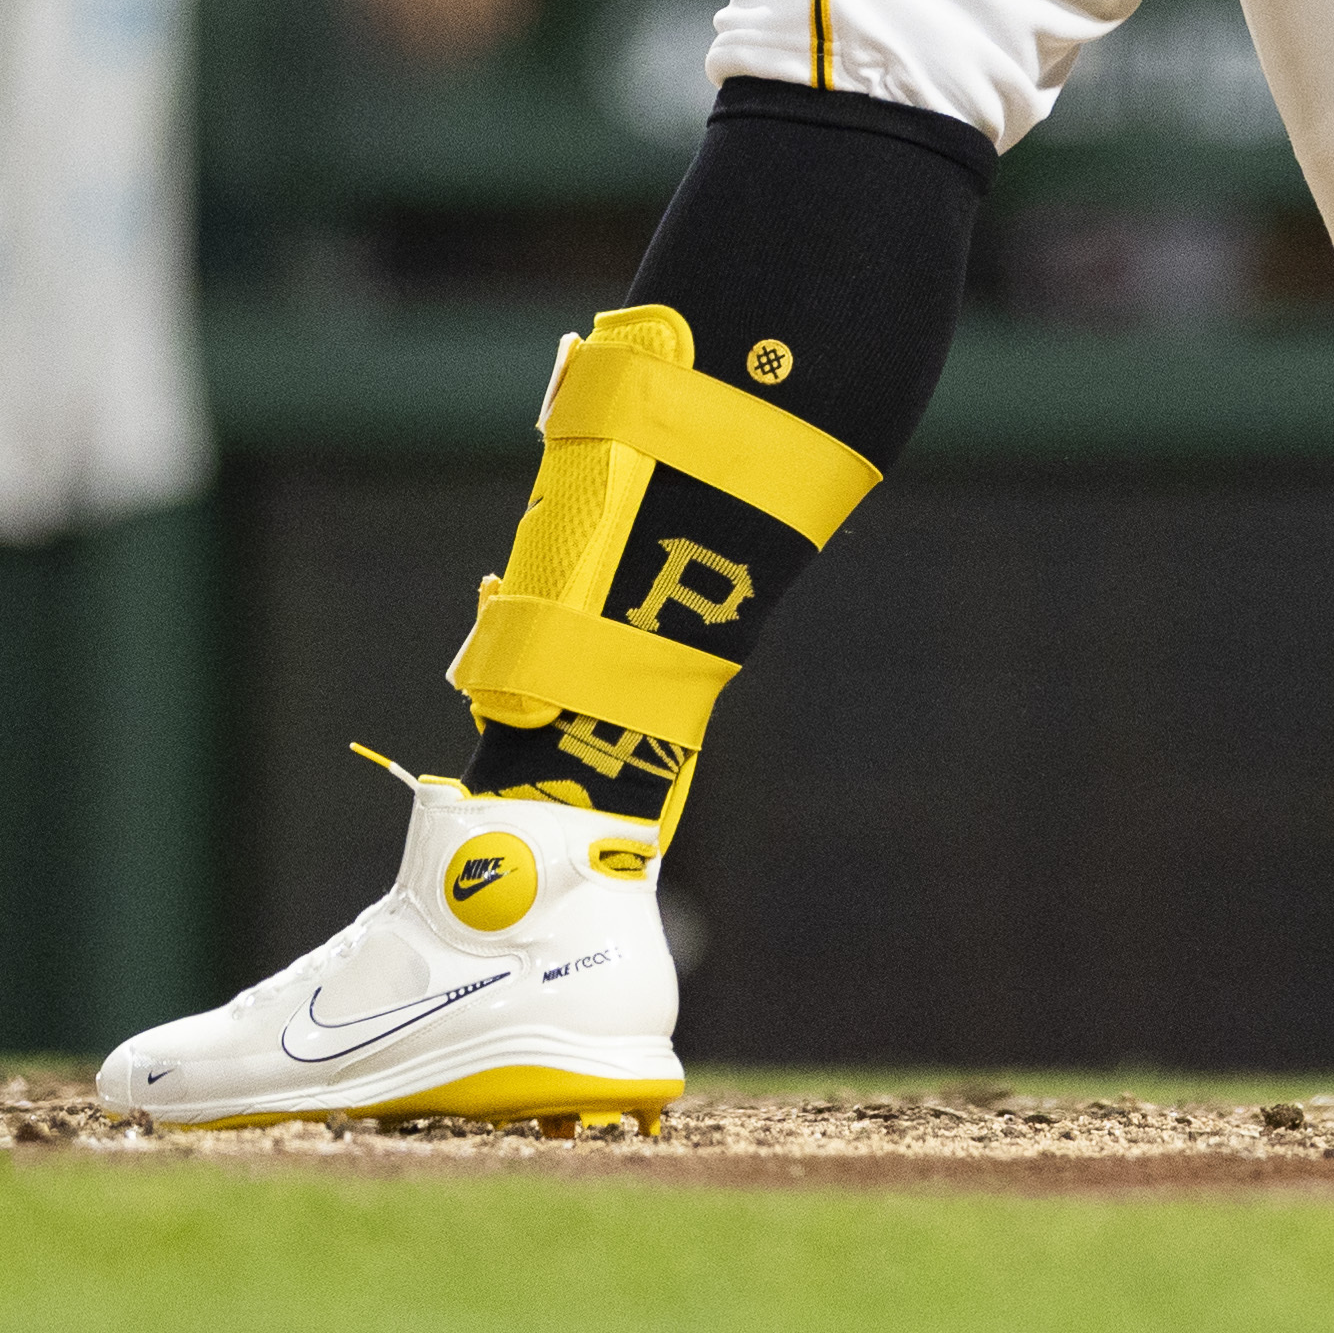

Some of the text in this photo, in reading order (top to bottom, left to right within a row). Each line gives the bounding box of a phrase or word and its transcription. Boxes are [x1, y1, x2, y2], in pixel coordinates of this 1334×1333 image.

[626, 537, 755, 633] P
[456, 856, 505, 882] NIKE
[542, 962, 571, 984] NIKE
